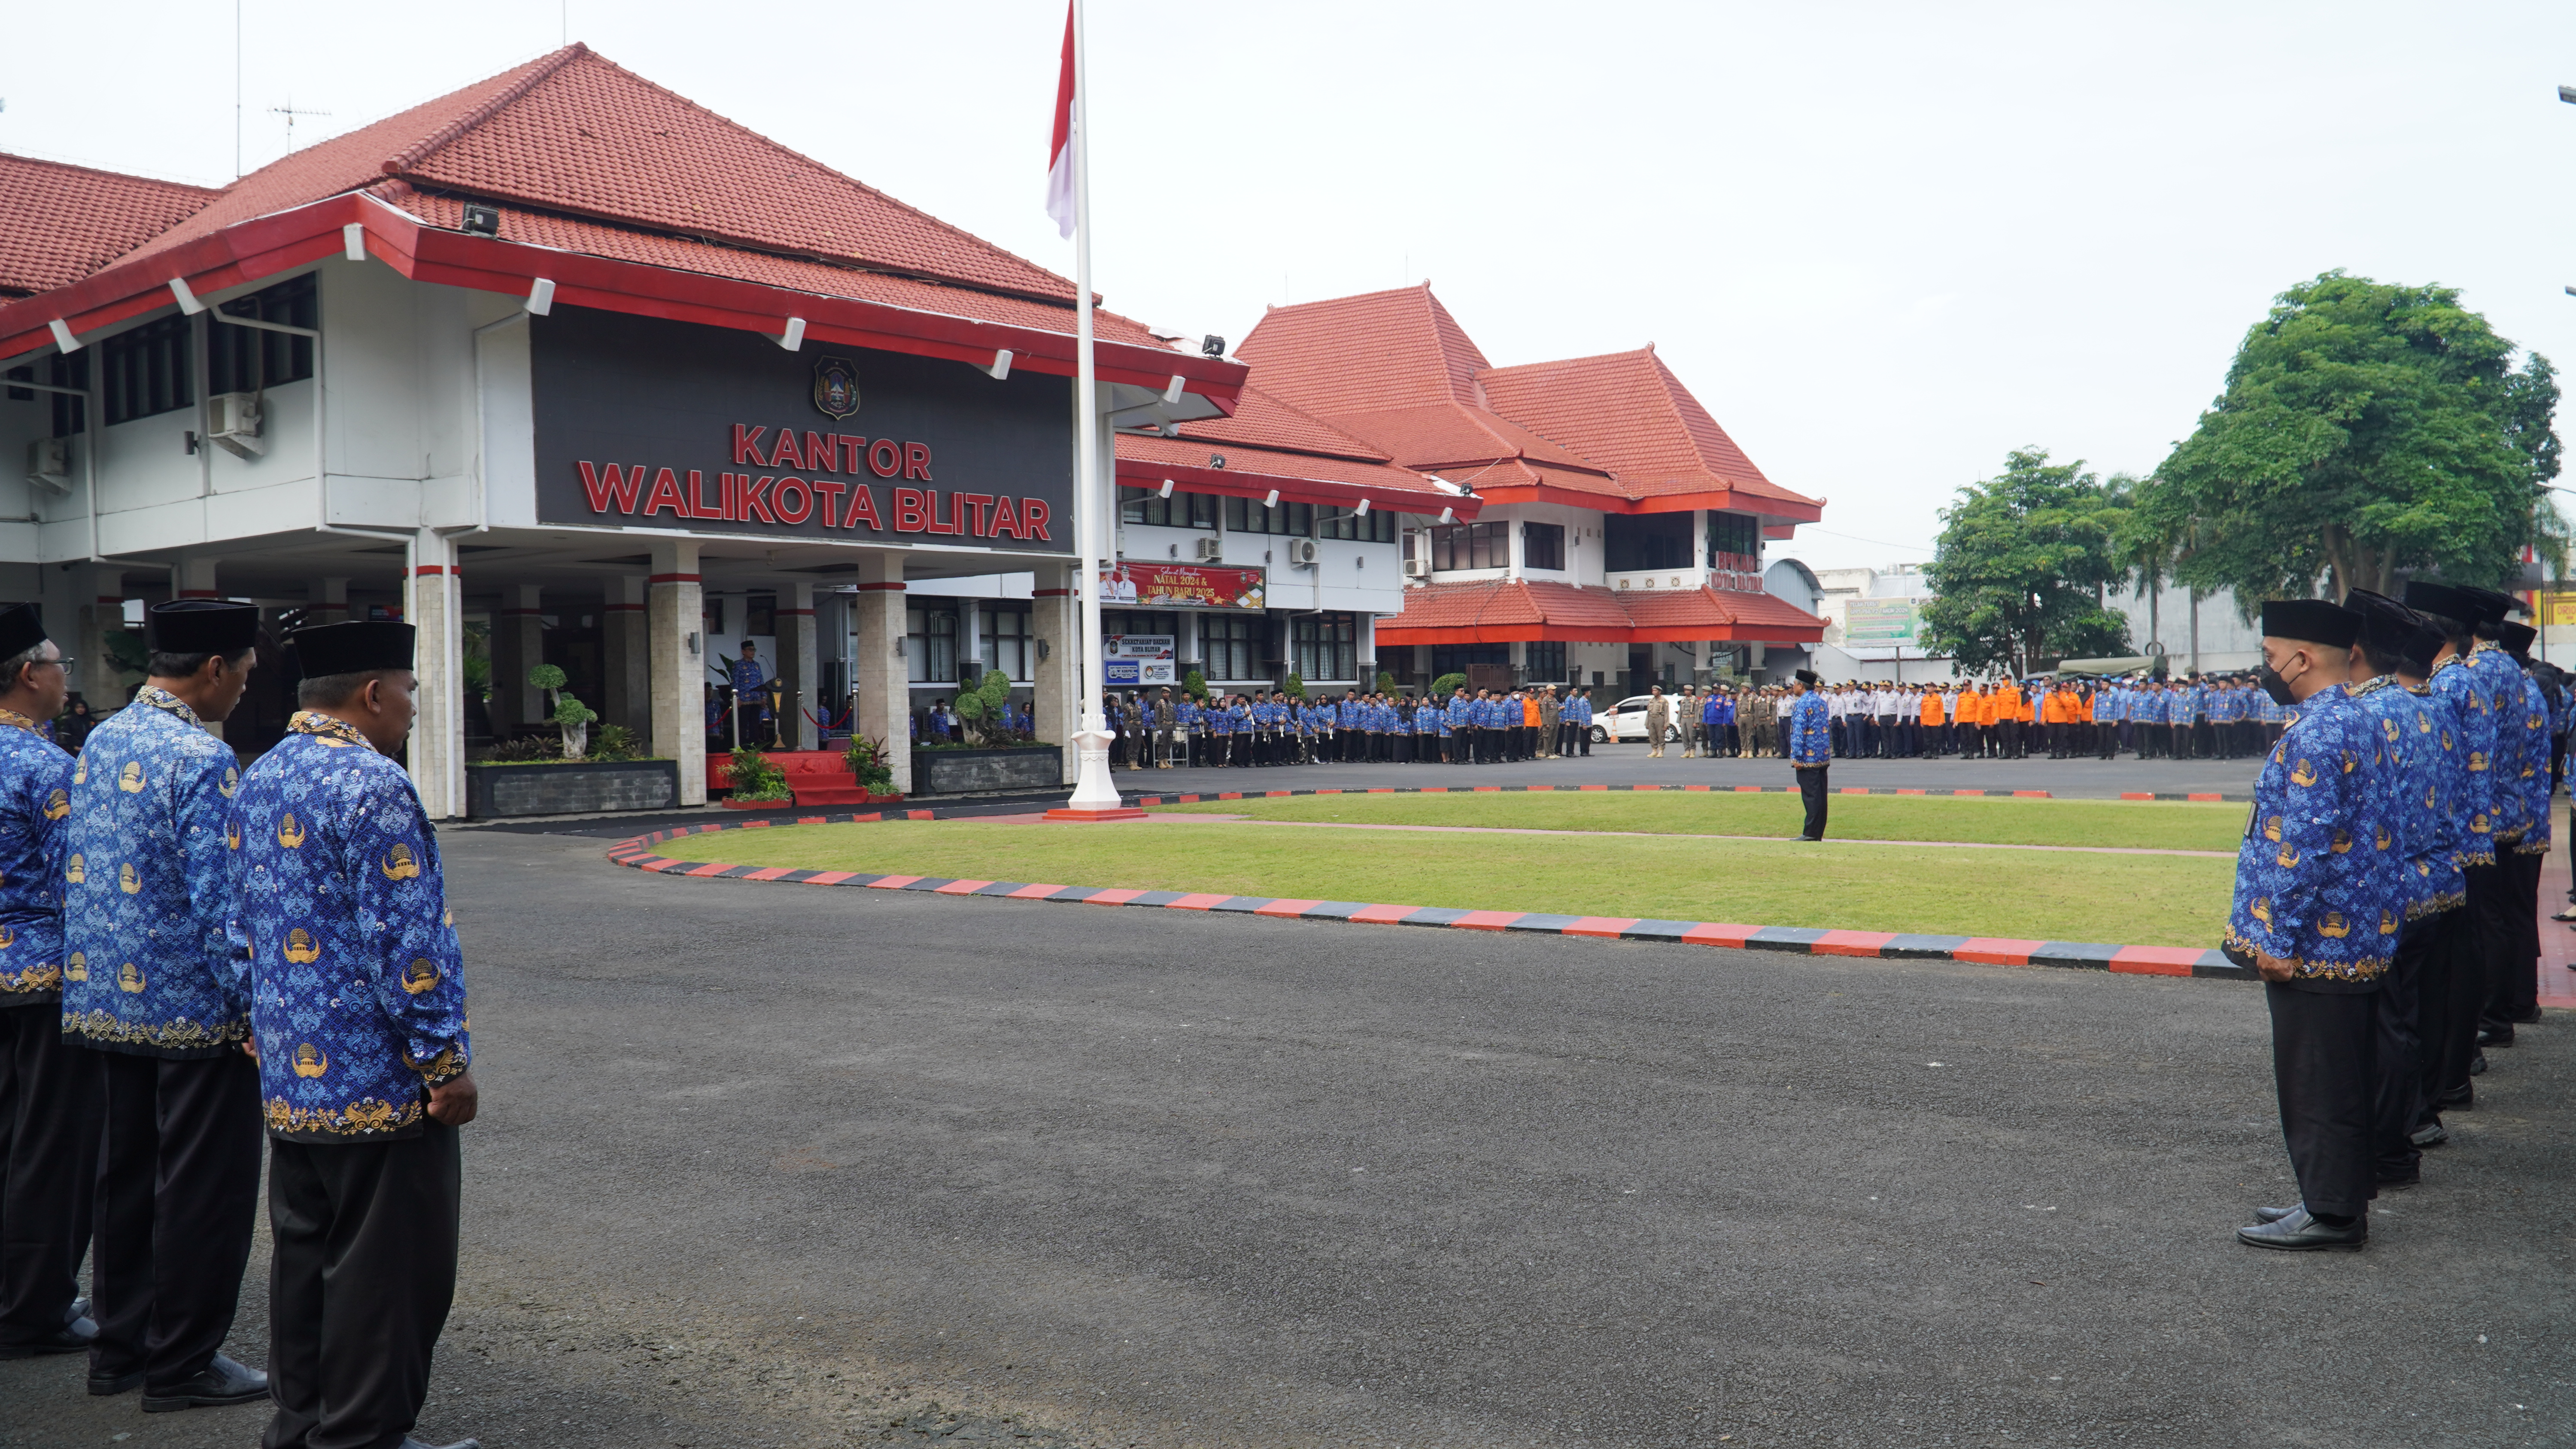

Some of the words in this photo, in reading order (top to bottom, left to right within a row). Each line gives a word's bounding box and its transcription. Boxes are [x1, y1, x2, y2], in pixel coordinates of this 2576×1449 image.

[732, 423, 933, 481] KANTOR
[577, 461, 883, 530] WALIKOTA
[893, 487, 1051, 540] BLITAR
[1160, 567, 1179, 575] Selamat
[1716, 551, 1755, 572] BPKAD
[1154, 574, 1179, 584] NATAL
[1180, 576, 1200, 585] 2024
[1201, 577, 1207, 586] &
[1711, 572, 1733, 588] KOTA
[1735, 575, 1763, 591] BLITAR
[1146, 585, 1173, 595] TAHUN
[1174, 586, 1195, 596] BARU
[1196, 588, 1215, 597] 2025
